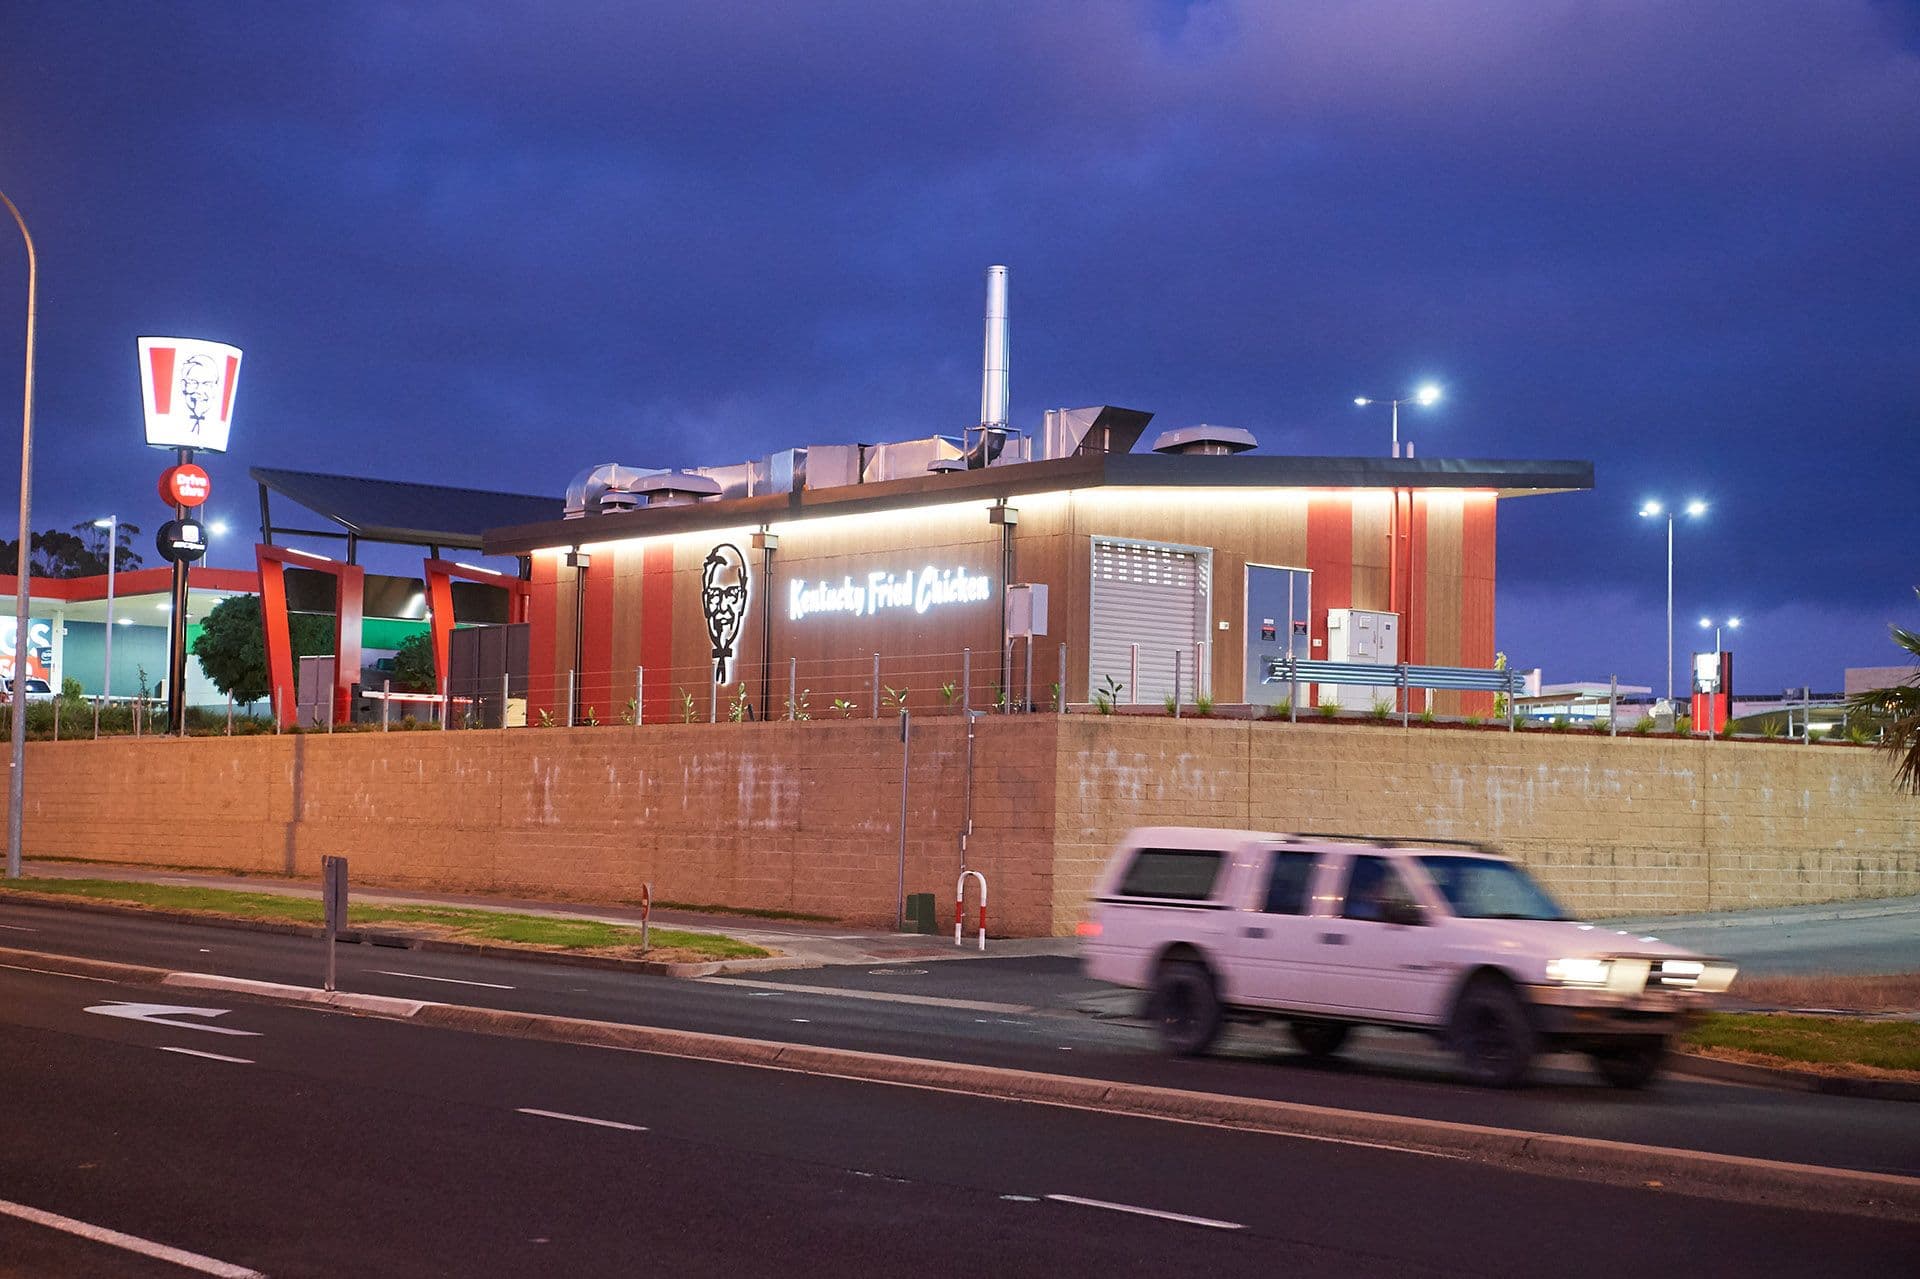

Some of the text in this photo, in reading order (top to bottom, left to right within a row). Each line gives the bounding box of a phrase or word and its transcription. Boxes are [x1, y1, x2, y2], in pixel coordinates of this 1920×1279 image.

[176, 473, 207, 487] Drive
[179, 485, 205, 497] thru
[789, 565, 990, 620] Kentucky Fried Chicken
